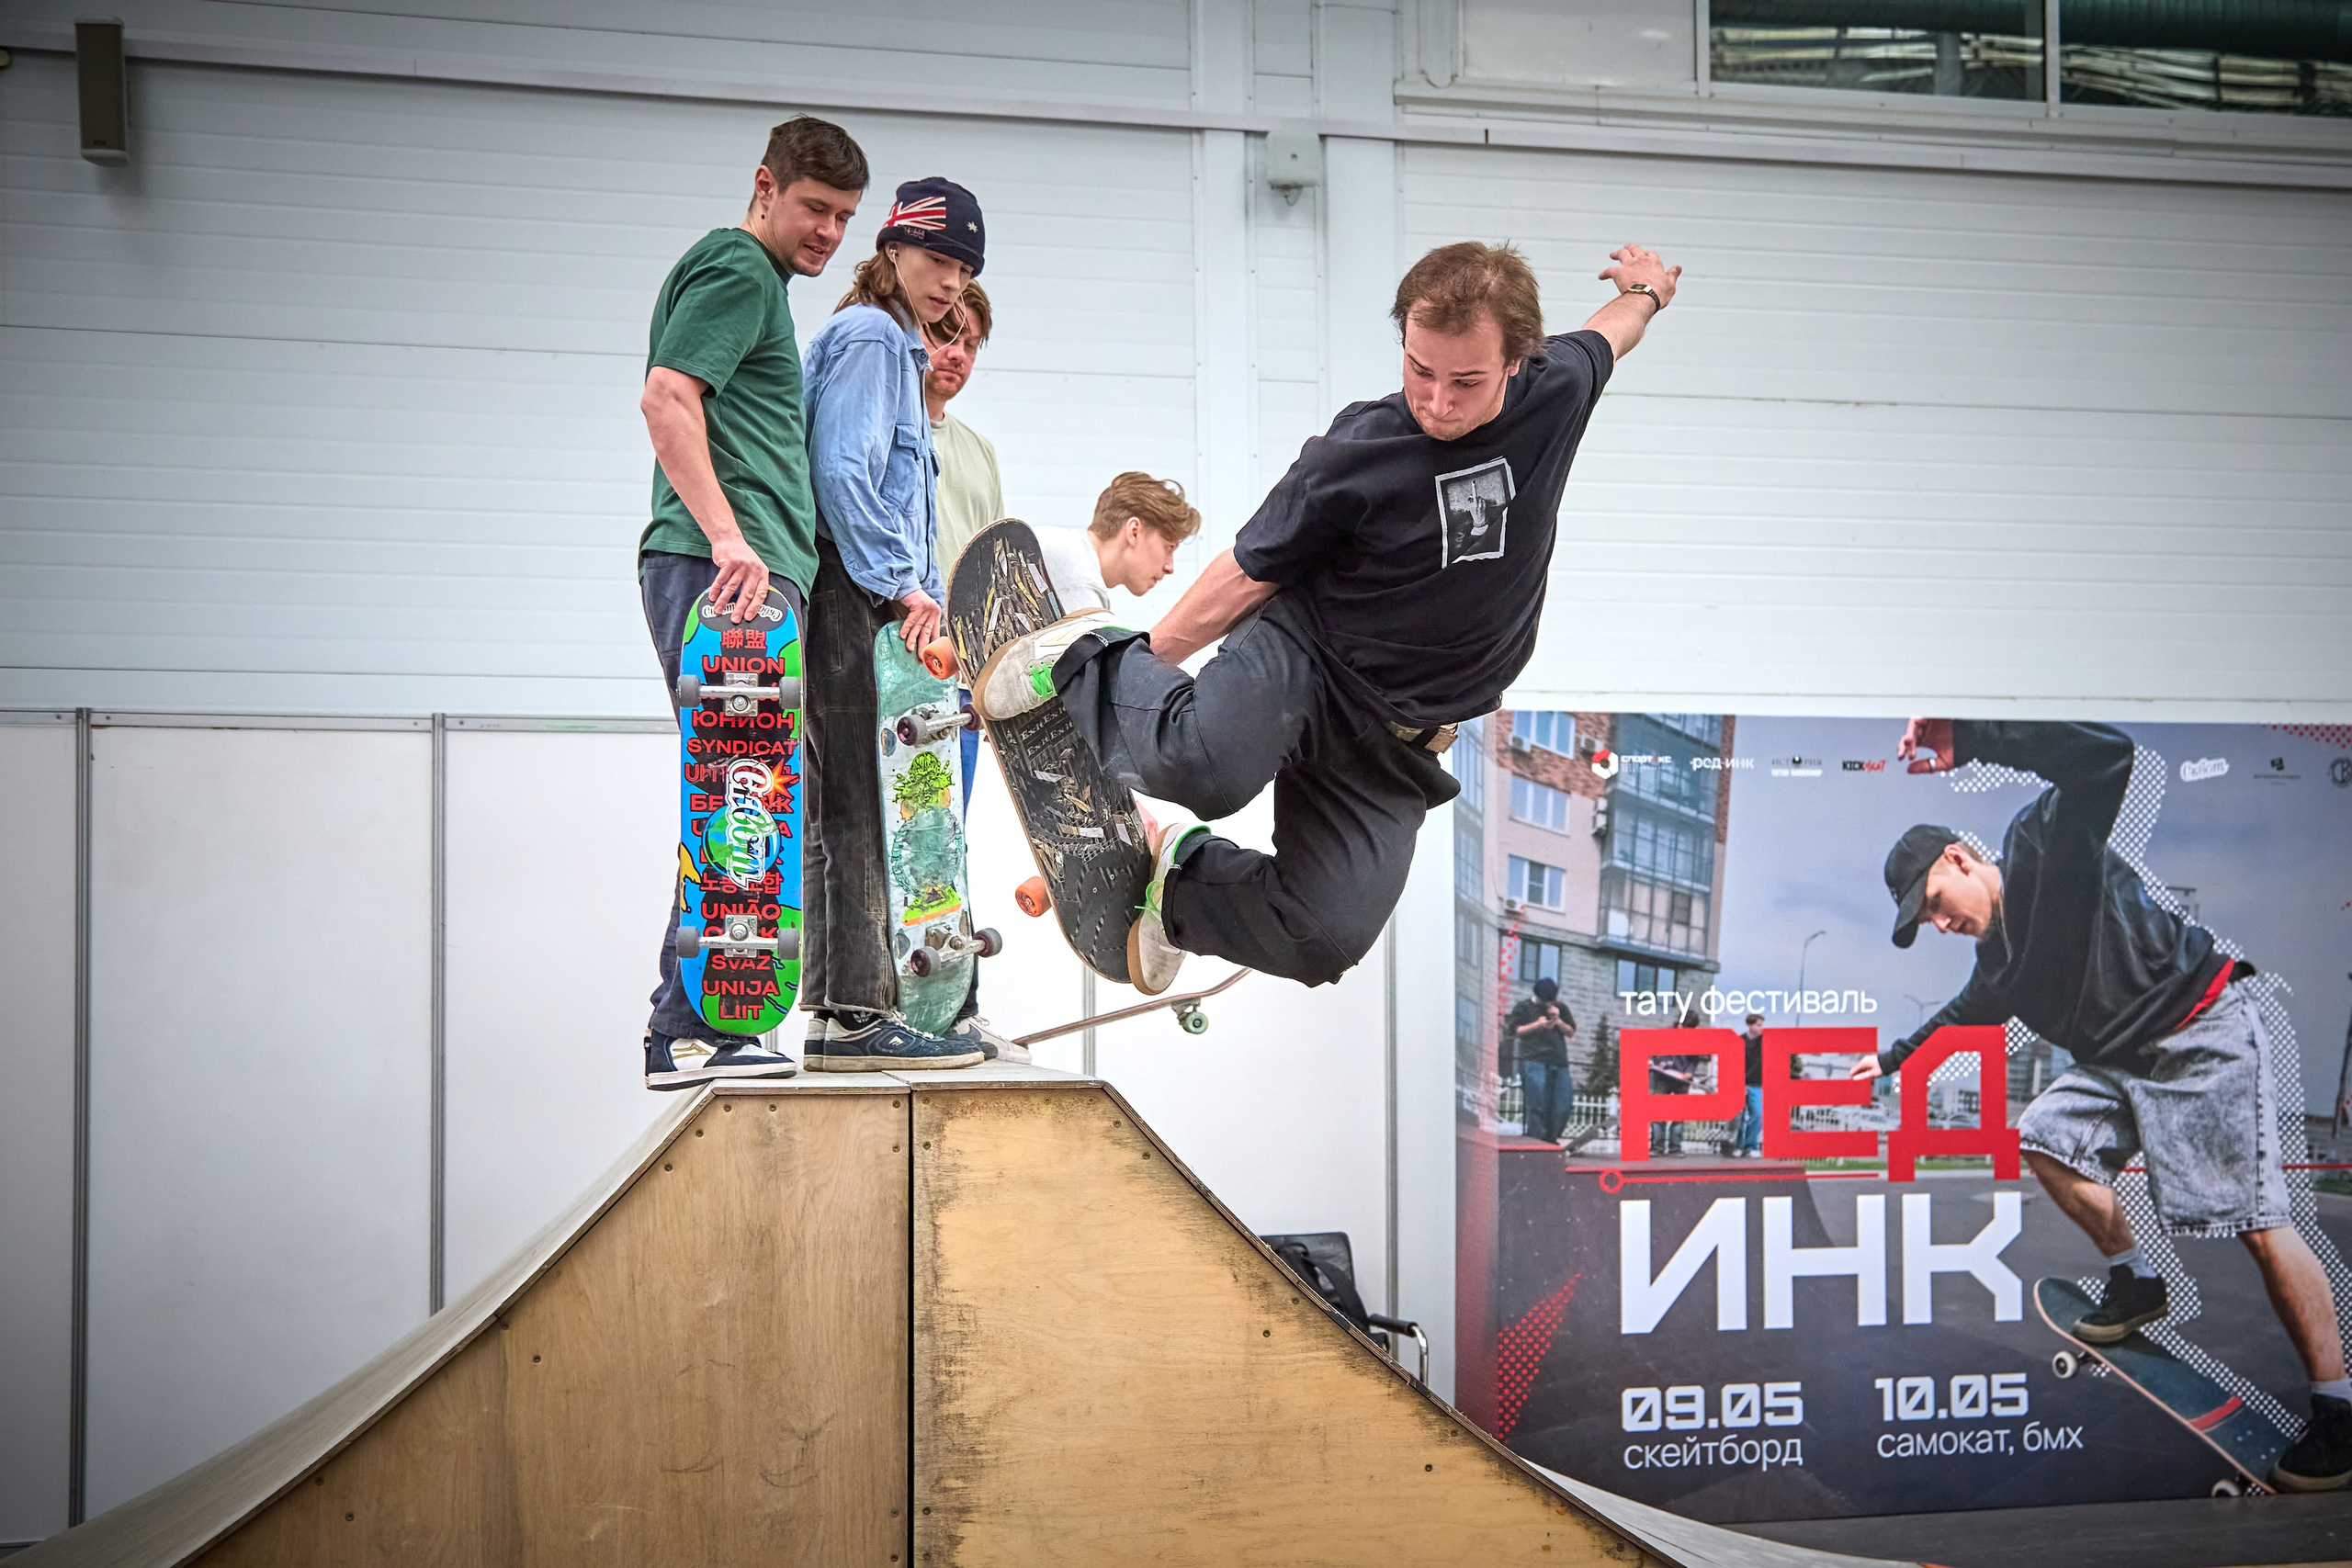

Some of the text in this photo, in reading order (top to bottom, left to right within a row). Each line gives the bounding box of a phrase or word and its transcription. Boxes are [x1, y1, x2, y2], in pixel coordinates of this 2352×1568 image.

[721, 628, 766, 649] 聯盟
[703, 656, 784, 673] UNION
[687, 738, 797, 754] SYNDICAT
[701, 899, 781, 919] UNIÃO
[711, 954, 771, 970] SVAZ
[703, 980, 779, 995] UNIJA
[719, 1005, 763, 1020] LIIT
[1620, 985, 1877, 1023] тату фестиваль
[1620, 1025, 2020, 1182] РЕД
[1620, 1191, 2022, 1334] ИНК
[1622, 1382, 1804, 1432] 09.05
[1875, 1372, 2029, 1421] 10.05
[1623, 1435, 1803, 1472] скейтборд
[1877, 1421, 2084, 1459] самокат, бмх
